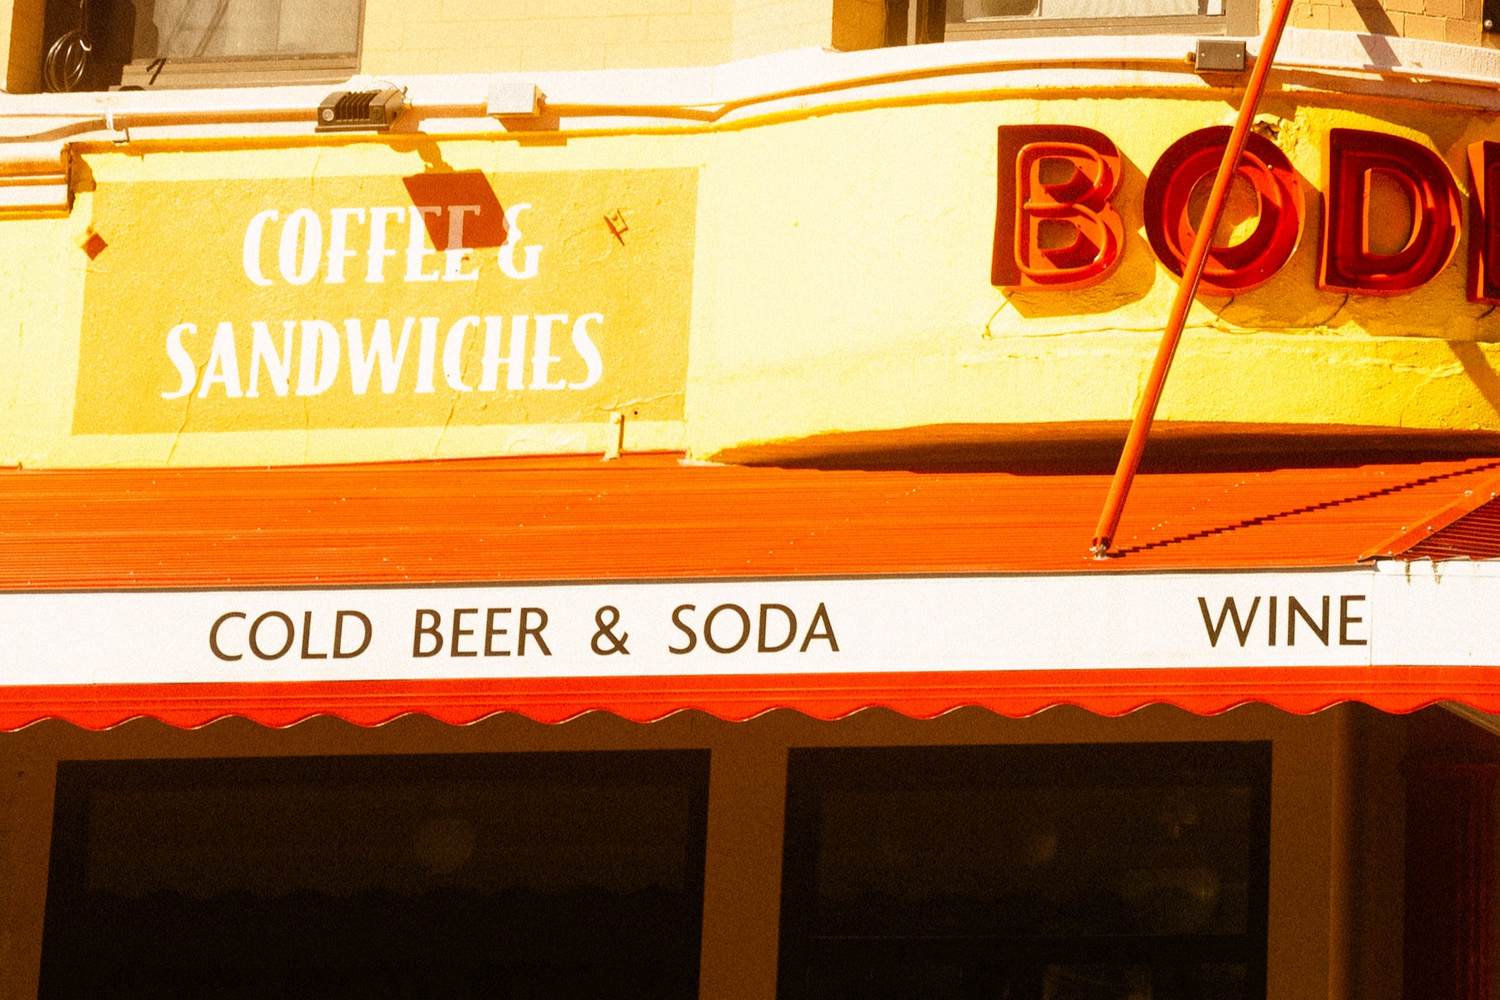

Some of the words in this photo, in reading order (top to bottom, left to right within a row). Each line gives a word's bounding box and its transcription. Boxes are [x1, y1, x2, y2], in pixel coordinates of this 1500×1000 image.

[242, 204, 481, 287] COFFEE
[497, 203, 544, 280] &
[160, 313, 605, 400] SANDWICHES
[207, 610, 374, 662] COLD
[411, 607, 553, 658] BEER
[589, 605, 631, 656] &
[667, 603, 841, 656] SODA
[1197, 594, 1369, 648] WINE
